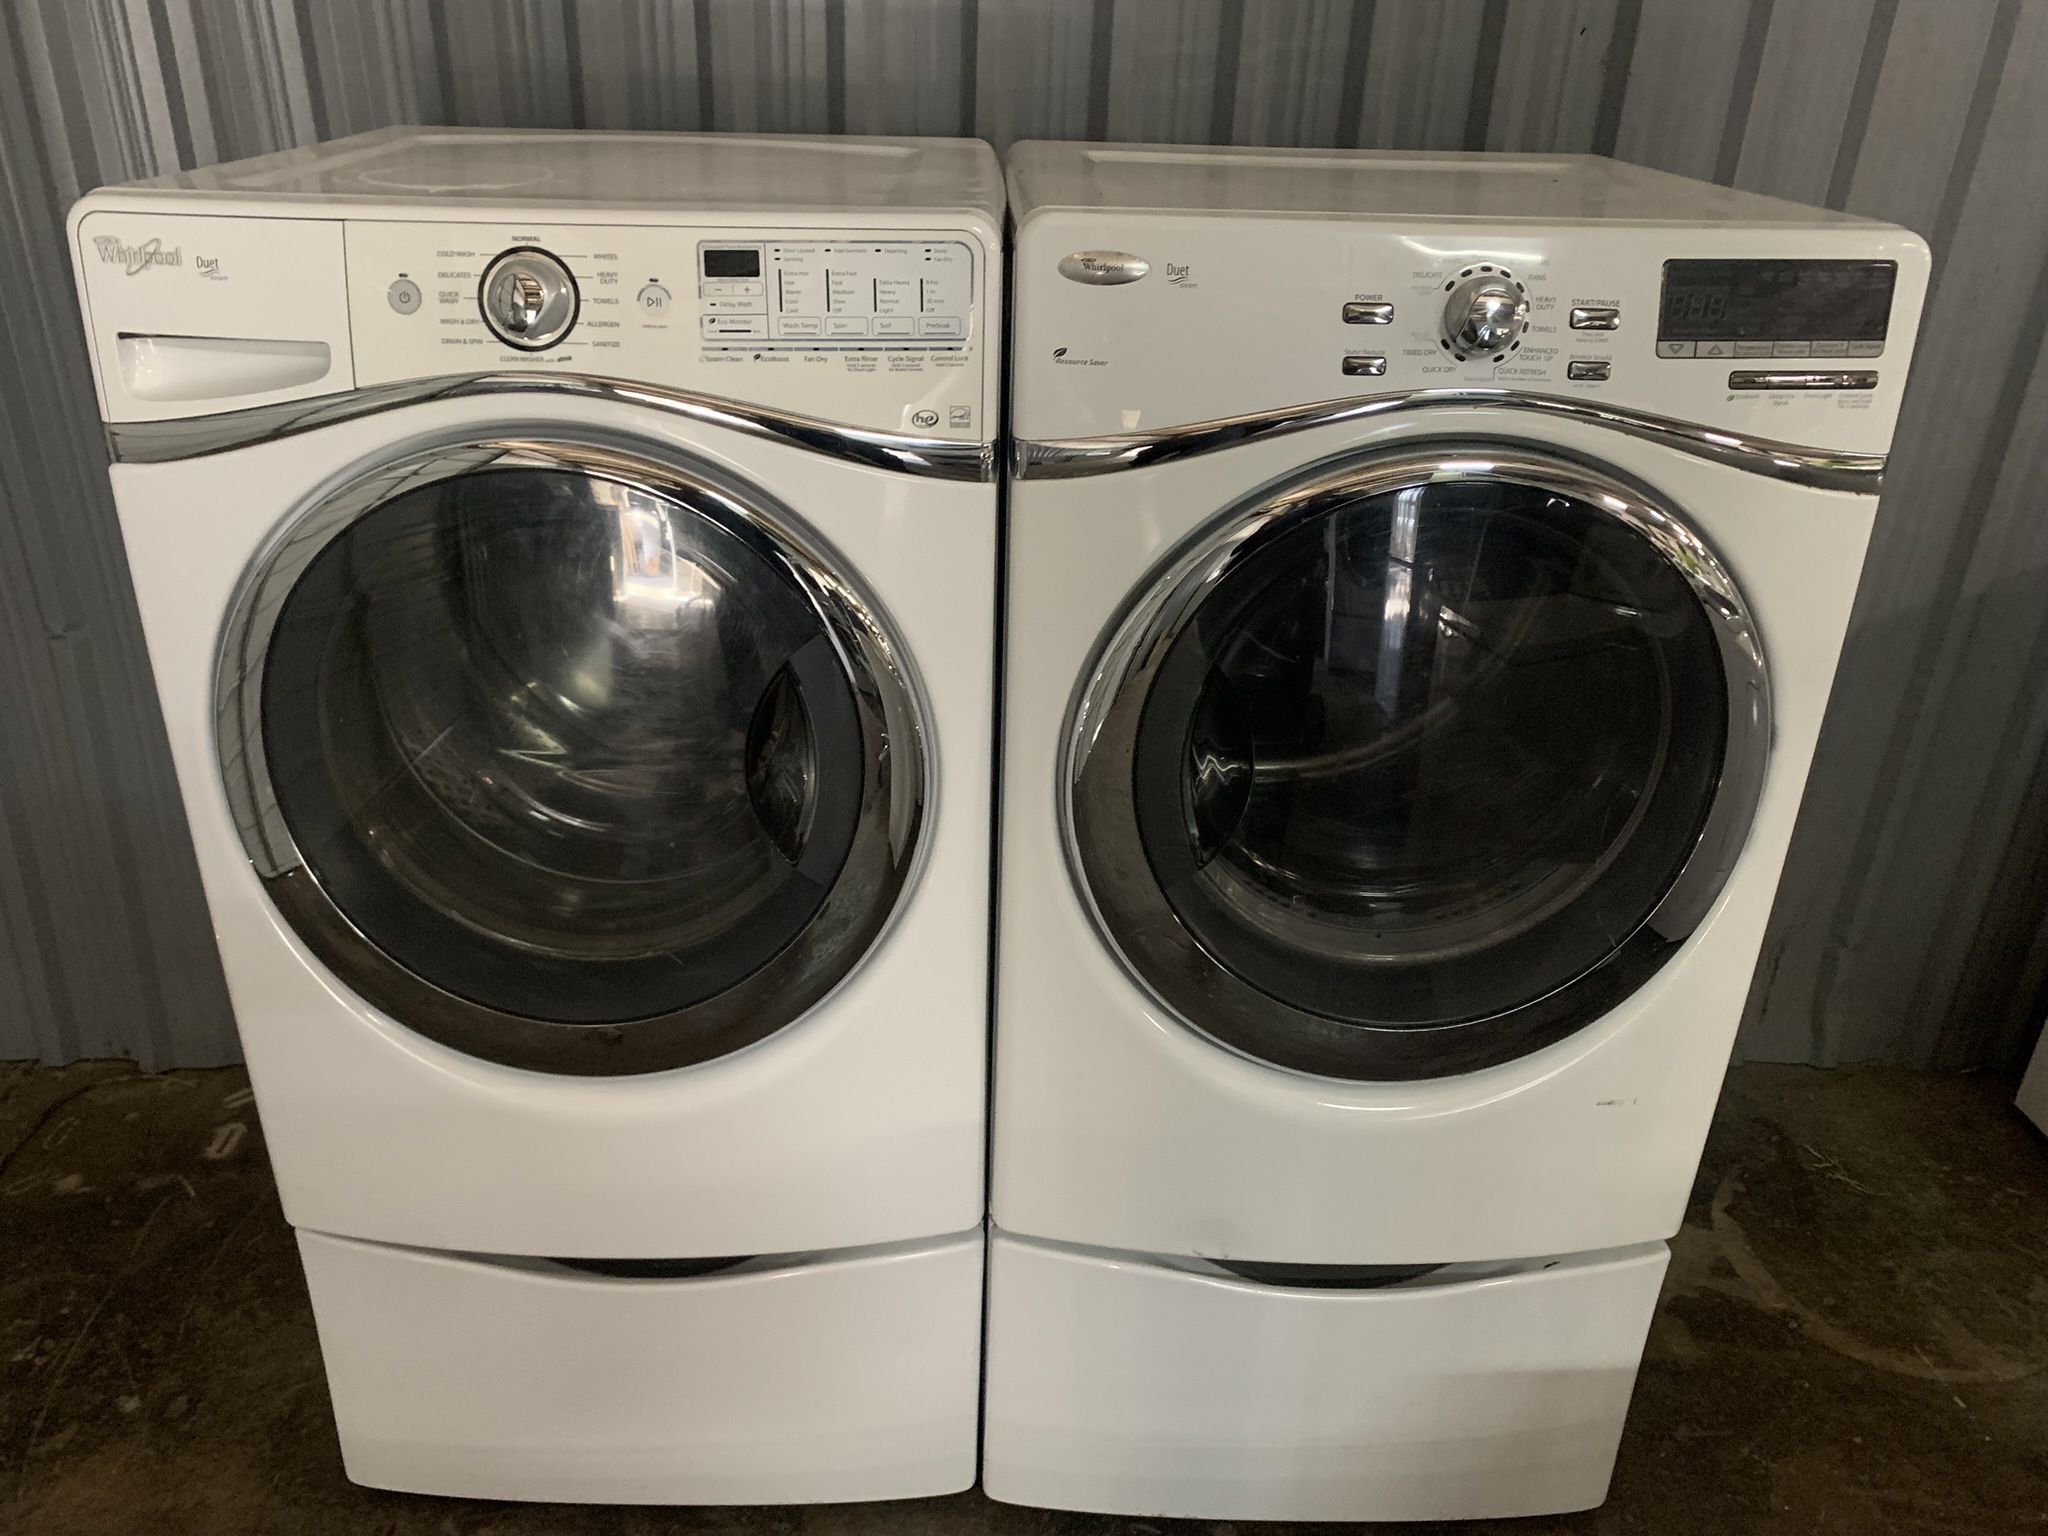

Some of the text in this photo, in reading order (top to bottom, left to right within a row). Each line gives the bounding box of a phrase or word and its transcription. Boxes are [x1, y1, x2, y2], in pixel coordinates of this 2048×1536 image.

[95, 240, 183, 271] Whirlpool
[436, 250, 475, 258] COLD WASH
[196, 256, 219, 269] Duet
[1083, 260, 1124, 273] Whirlpool
[1166, 263, 1189, 276] Duet
[1571, 299, 1620, 308] START/PAUSE
[1055, 357, 1108, 367] Resource Saver
